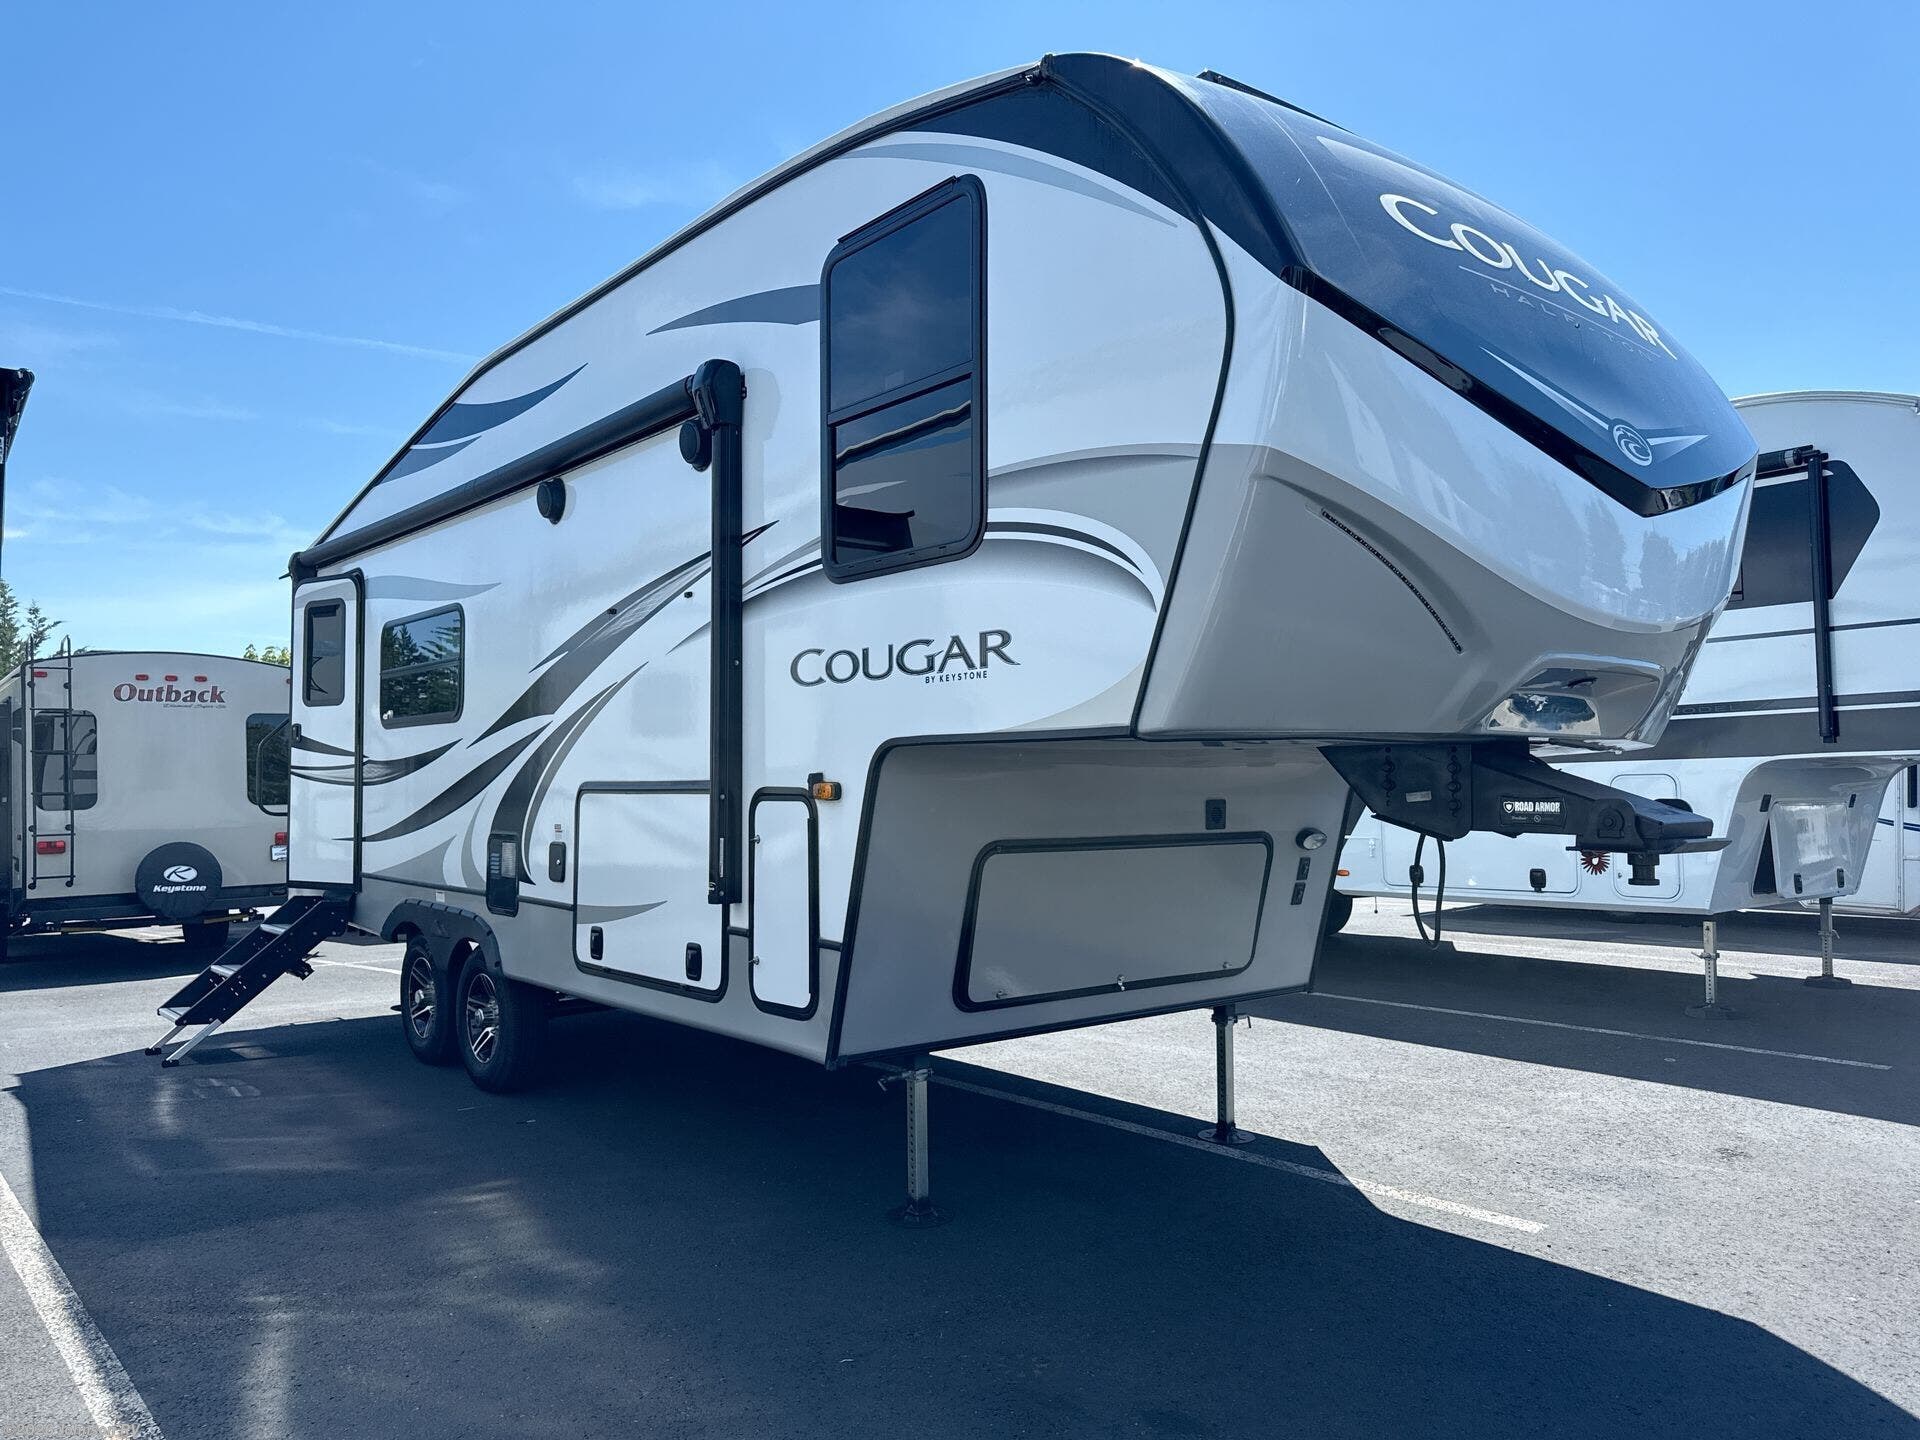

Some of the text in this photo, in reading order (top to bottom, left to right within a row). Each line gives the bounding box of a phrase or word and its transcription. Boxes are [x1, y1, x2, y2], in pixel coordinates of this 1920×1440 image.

[1379, 193, 1678, 361] COUGAR
[789, 629, 1021, 687] COUGAR
[925, 671, 988, 684] BY KEYSTONE
[113, 683, 226, 703] Outback
[1676, 703, 1740, 715] ODEL
[1514, 801, 1560, 812] ROAD ARMOR
[153, 884, 207, 894] Keystone
